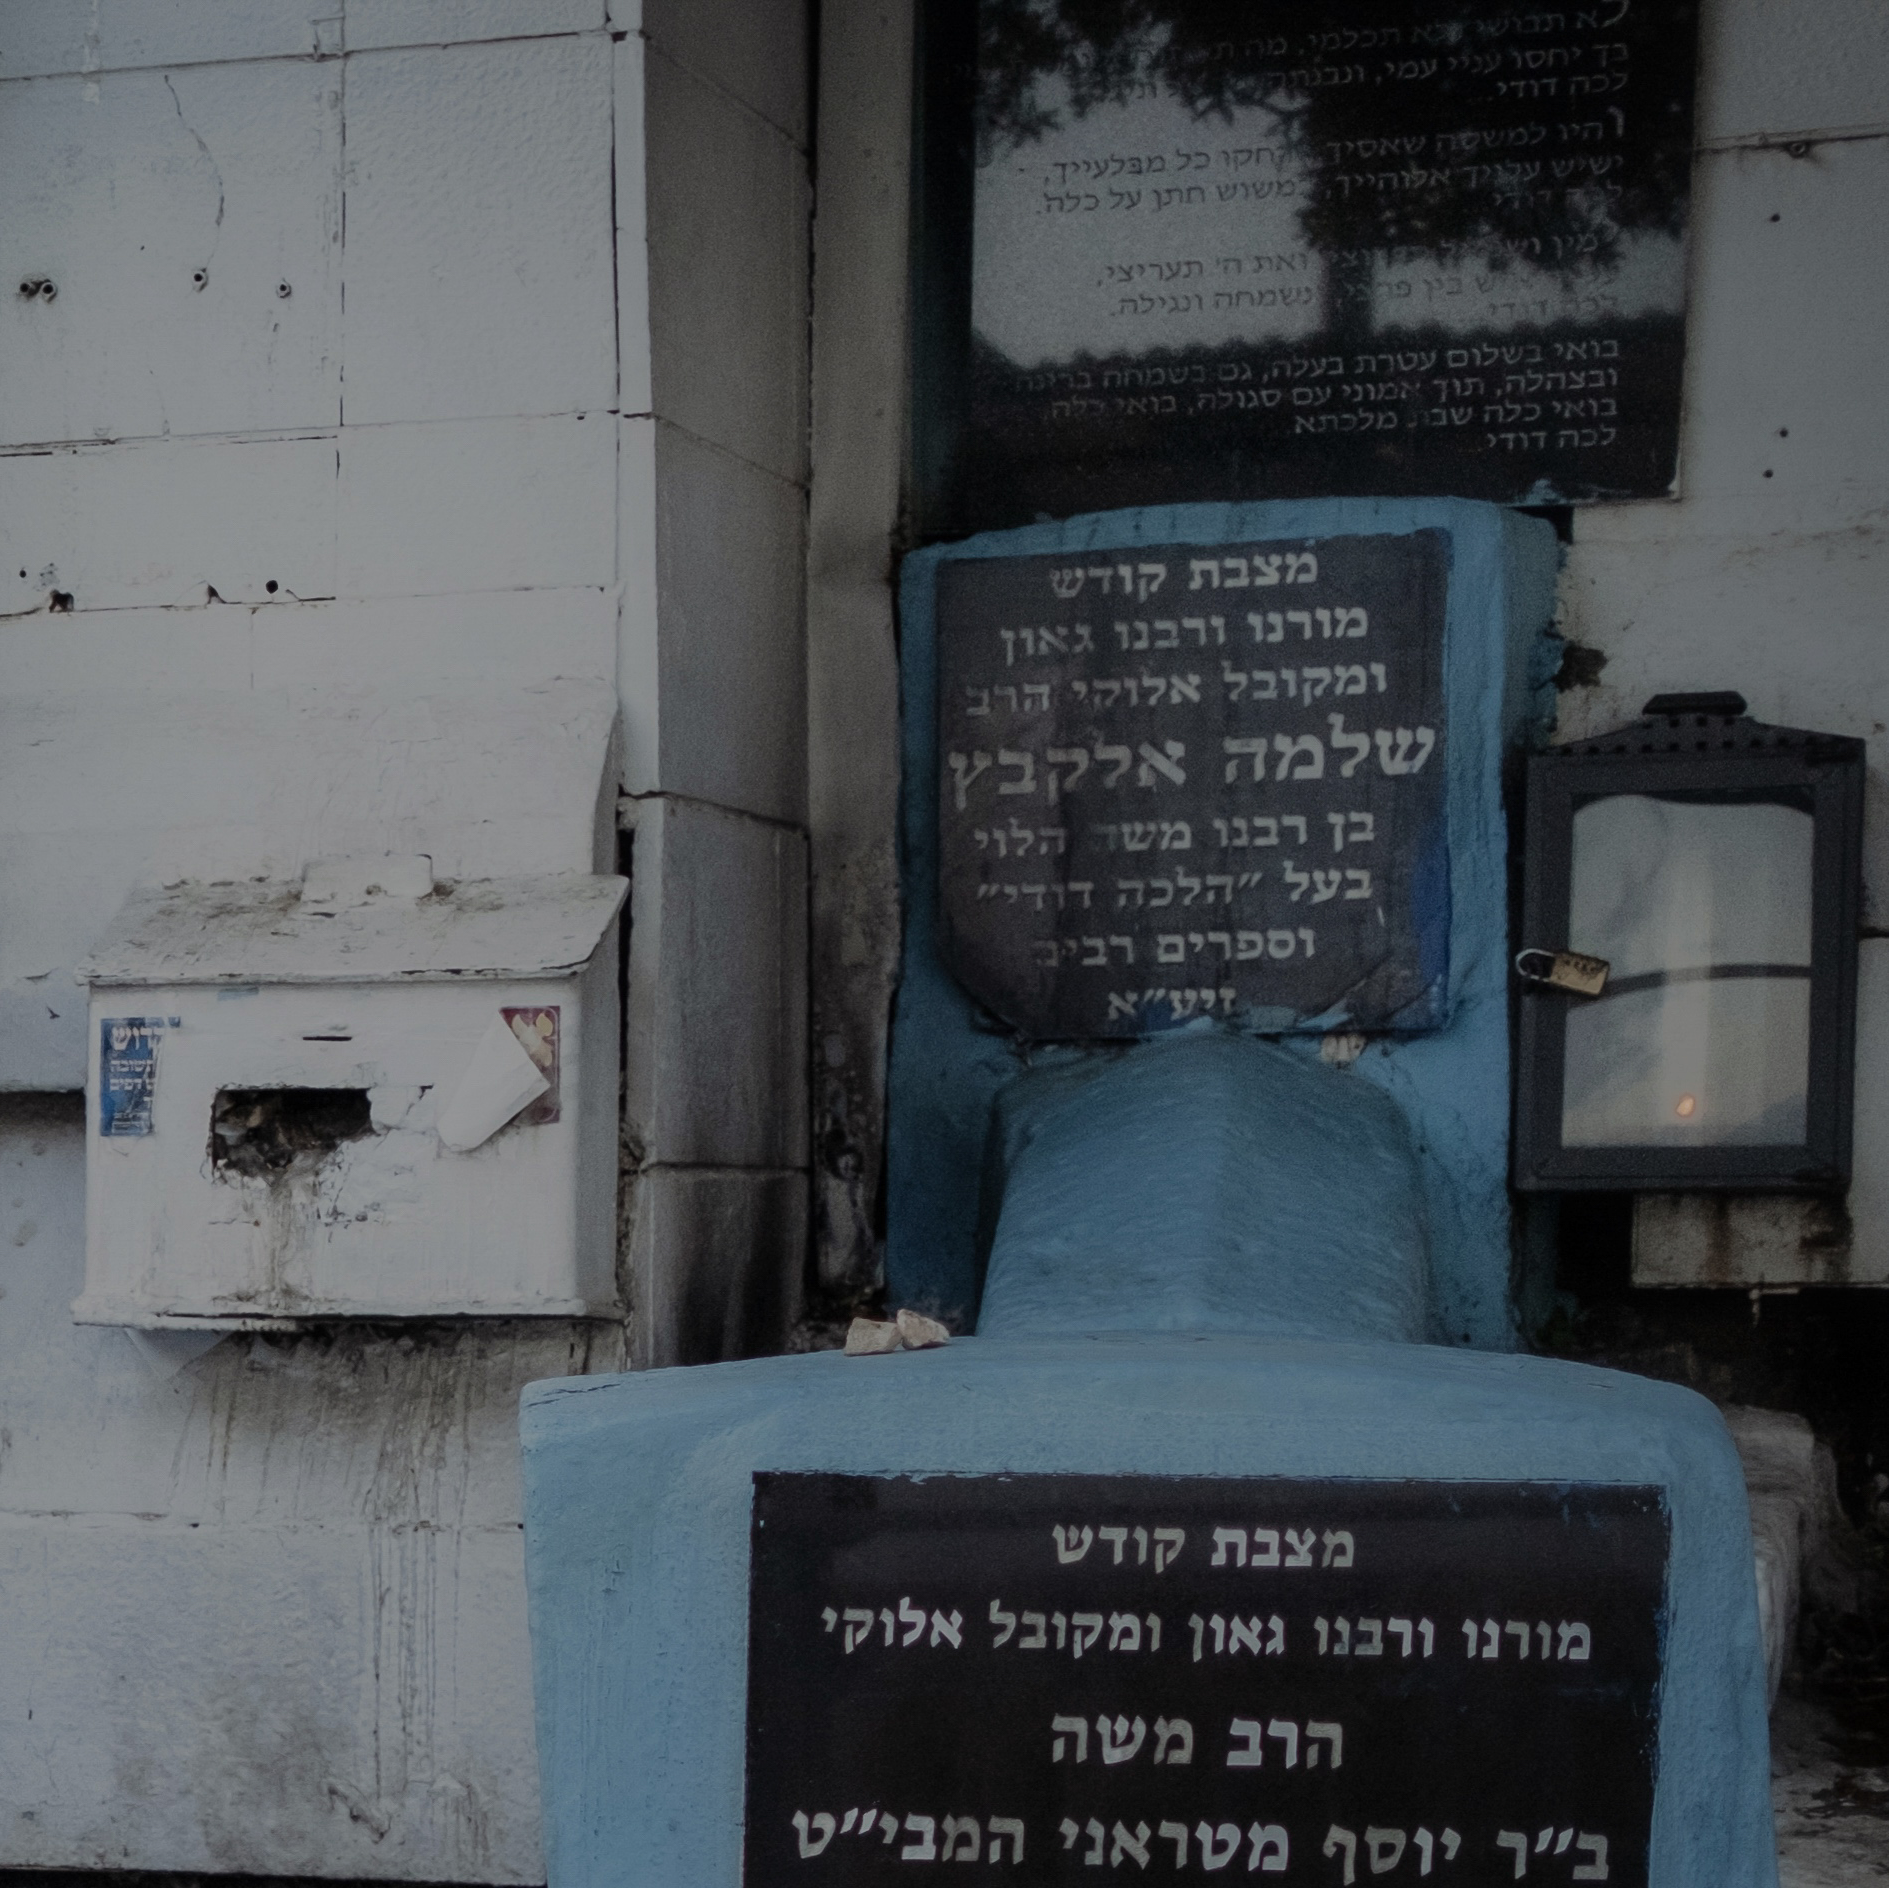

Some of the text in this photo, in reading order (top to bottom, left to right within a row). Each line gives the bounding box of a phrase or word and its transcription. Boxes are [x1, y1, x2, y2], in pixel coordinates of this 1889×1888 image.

[1051, 553, 1318, 603] מצבת קודש
[1000, 606, 1369, 666] מורנו ורבנו גאון
[967, 661, 1388, 715] ומקובל אלוקי הרב
[948, 712, 1437, 812] שלמה אלקבץ
[974, 817, 1065, 857] הלוי
[1212, 814, 1308, 847] רבנו
[1326, 810, 1376, 853] בן
[1281, 860, 1376, 904] בעל
[1156, 927, 1316, 964] וספרים
[1051, 1524, 1355, 1574] מצבת קודש
[821, 1596, 1592, 1661] מורנו ורבנו גאון ומקובל אלוקי
[1051, 1714, 1344, 1770] הרב משה
[1058, 1817, 1290, 1872] מטראני
[1322, 1823, 1462, 1885] יוסף
